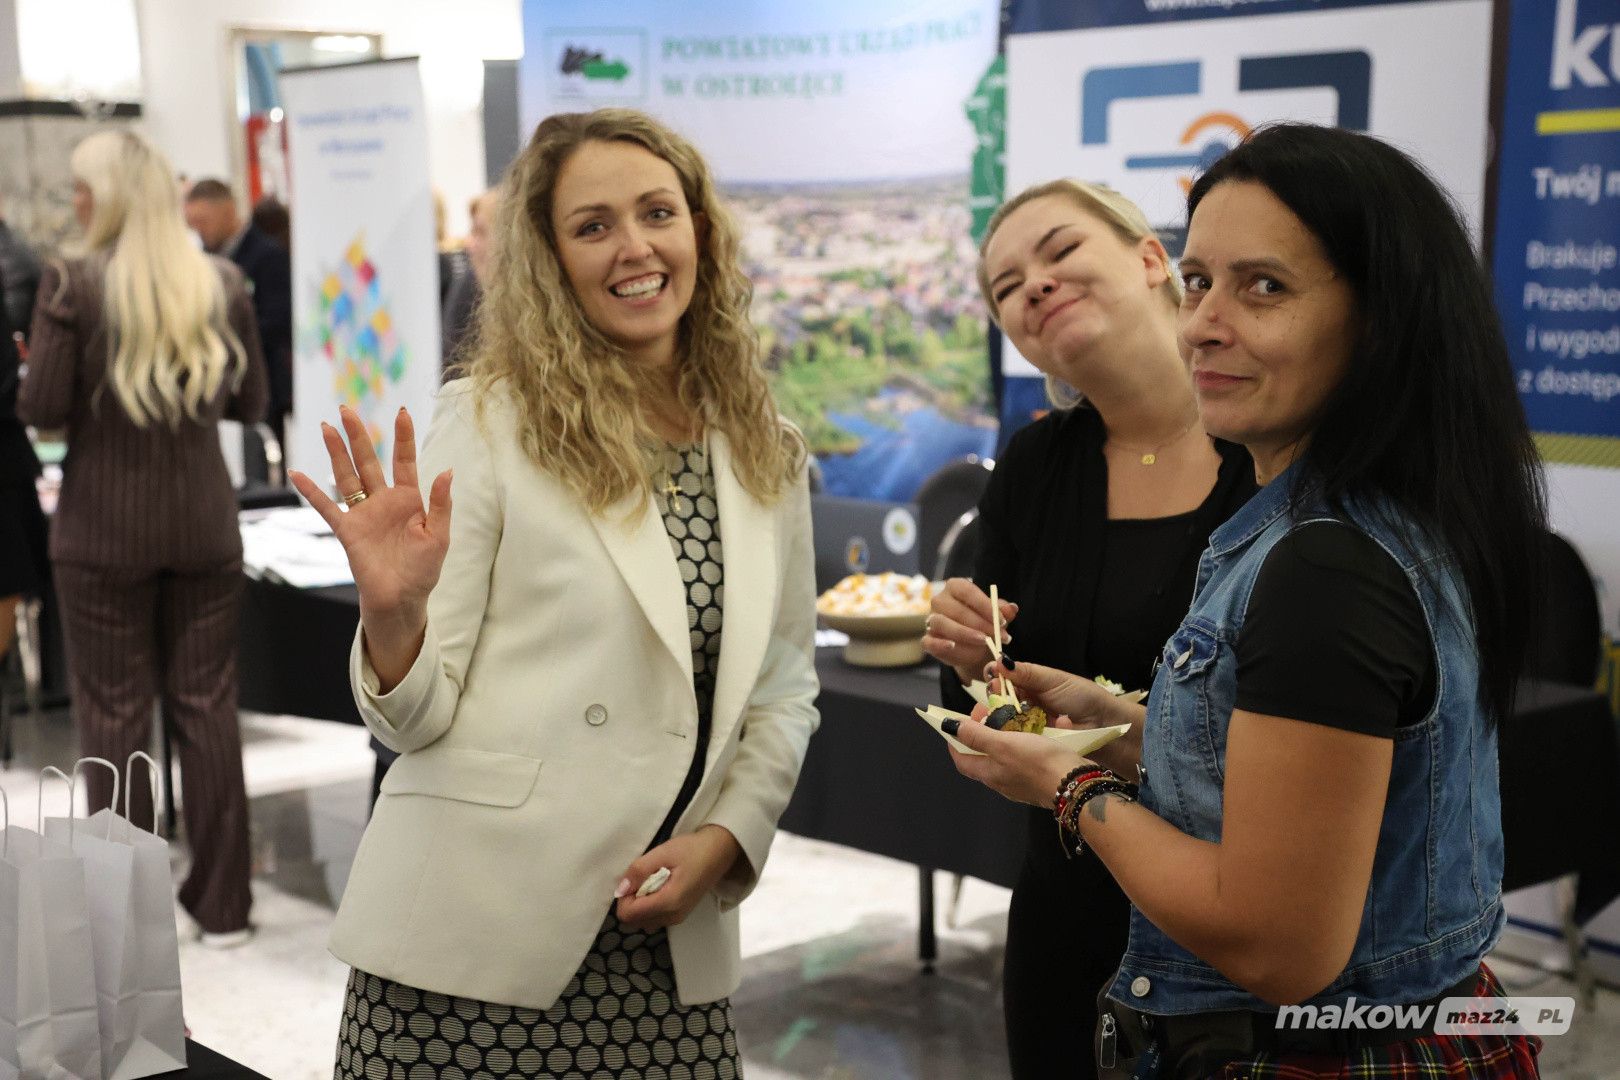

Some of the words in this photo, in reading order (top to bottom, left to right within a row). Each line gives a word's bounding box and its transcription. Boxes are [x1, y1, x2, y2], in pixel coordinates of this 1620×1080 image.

[1550, 0, 1620, 90] k
[1531, 165, 1602, 205] Twój
[1526, 239, 1617, 274] Brakuje
